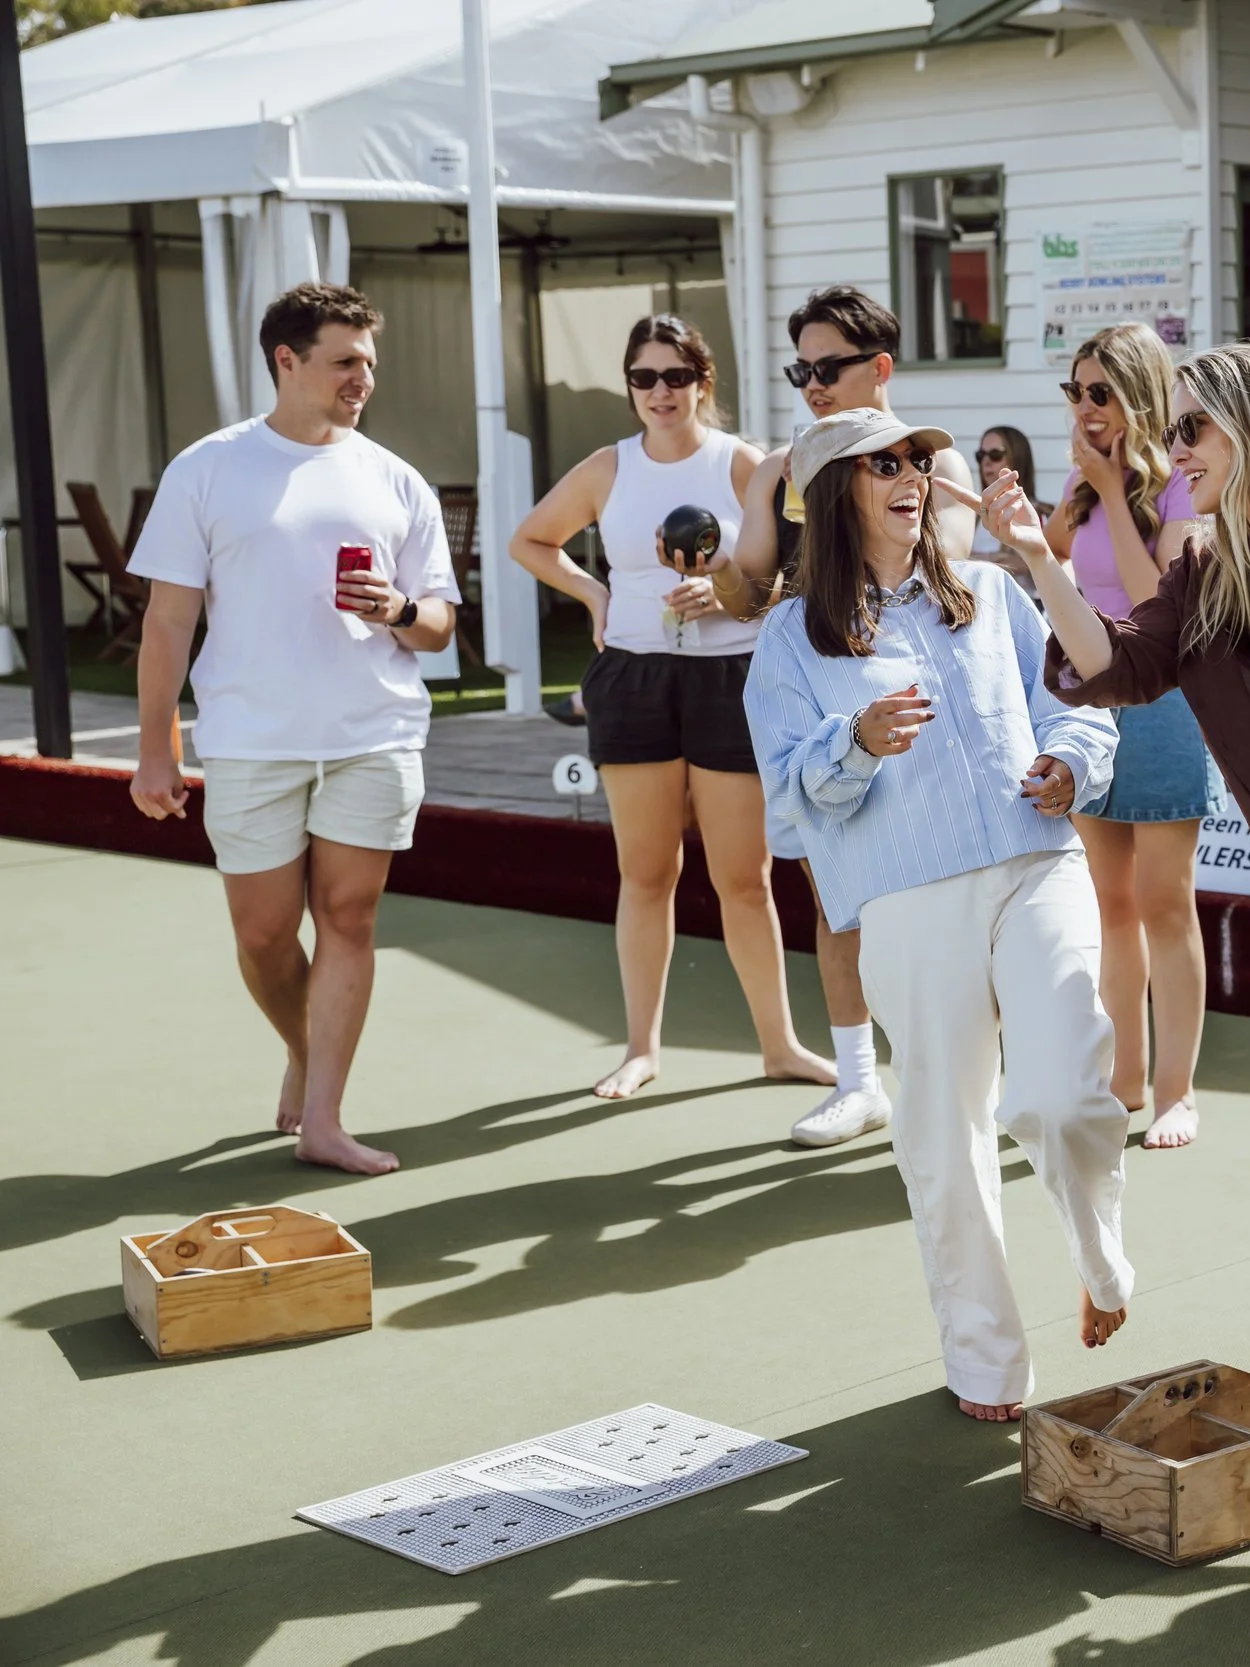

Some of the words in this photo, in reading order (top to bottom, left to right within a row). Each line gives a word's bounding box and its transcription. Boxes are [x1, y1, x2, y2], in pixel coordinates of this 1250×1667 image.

[1042, 232, 1079, 258] bbs
[567, 762, 581, 784] 6
[1202, 816, 1242, 834] een
